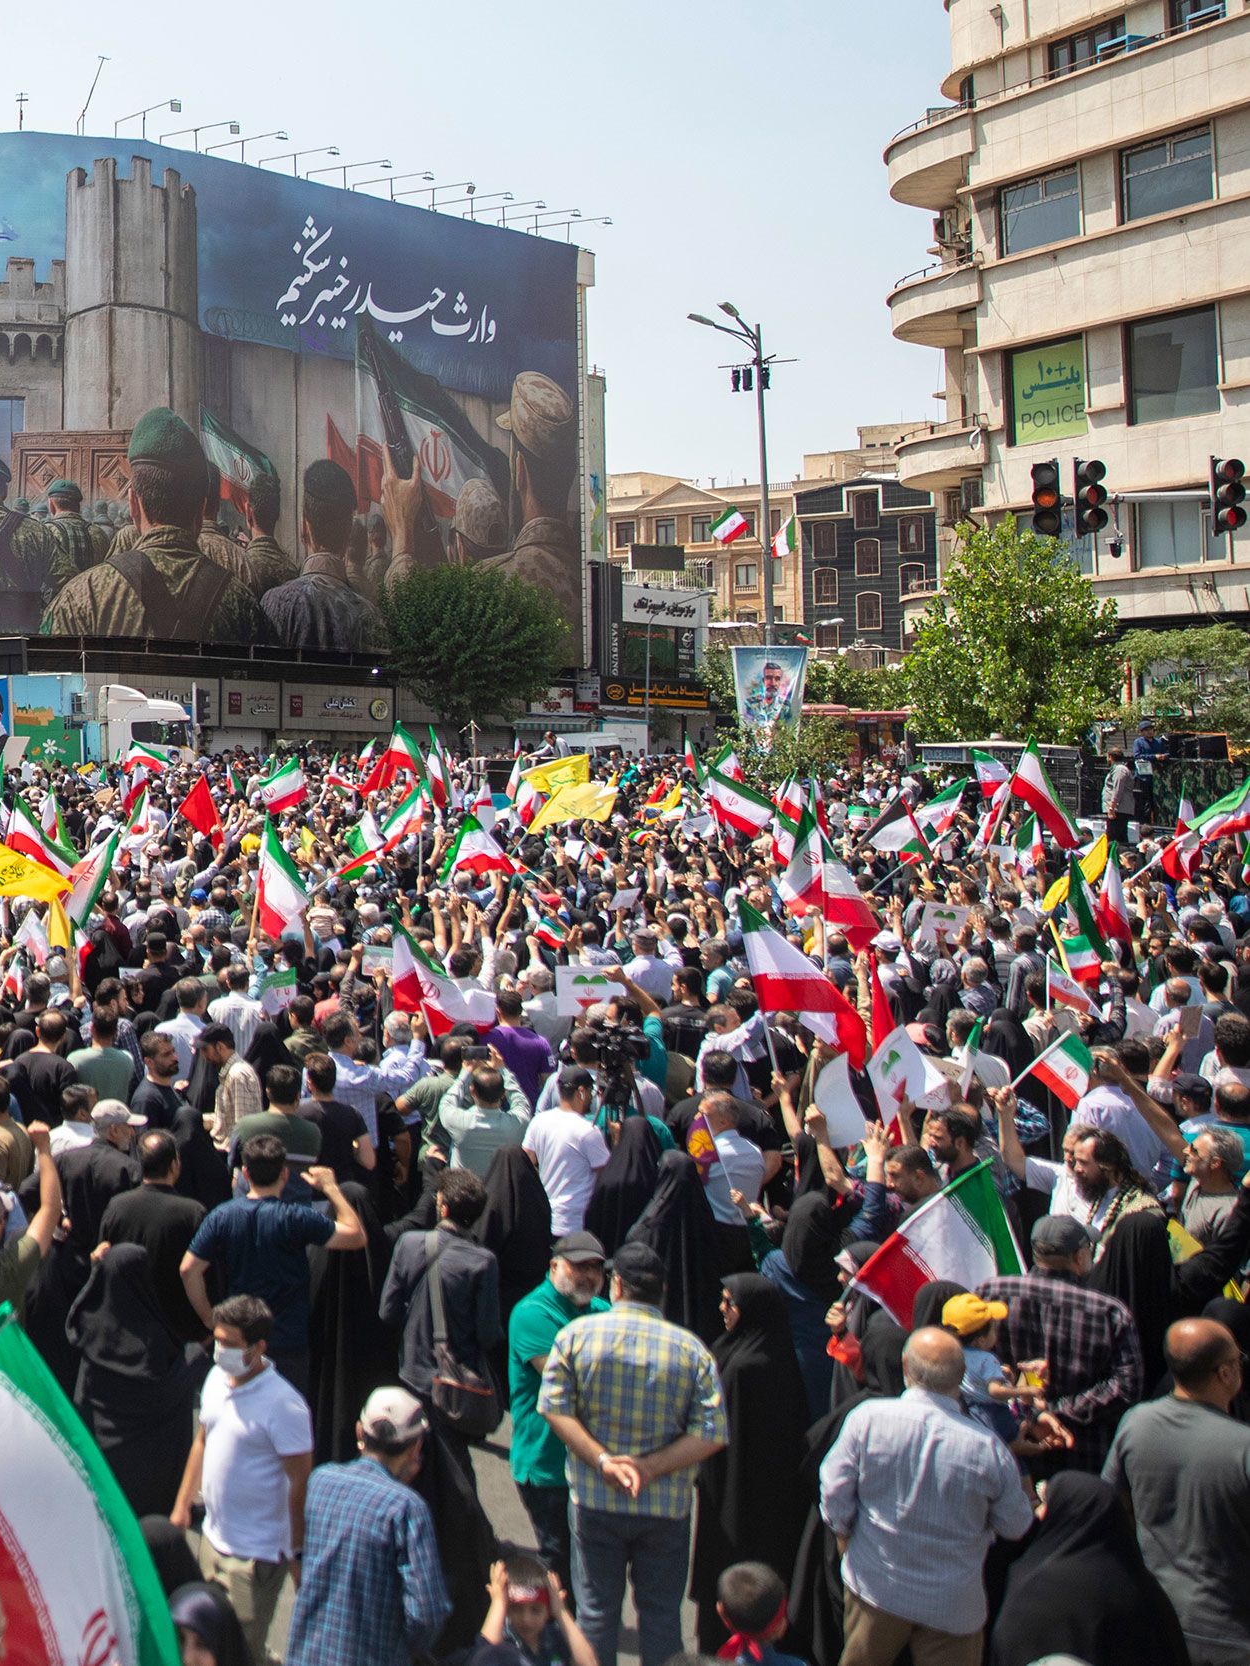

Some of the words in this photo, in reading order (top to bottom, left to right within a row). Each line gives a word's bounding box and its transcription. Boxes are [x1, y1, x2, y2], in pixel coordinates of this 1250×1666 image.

[342, 282, 446, 343] حیدر
[431, 291, 496, 343] وارث
[1022, 365, 1082, 400] پلیس
[1021, 402, 1086, 430] POLICE
[611, 622, 619, 676] SAMSUNG
[325, 697, 339, 709] ملی
[338, 697, 358, 710] کفش
